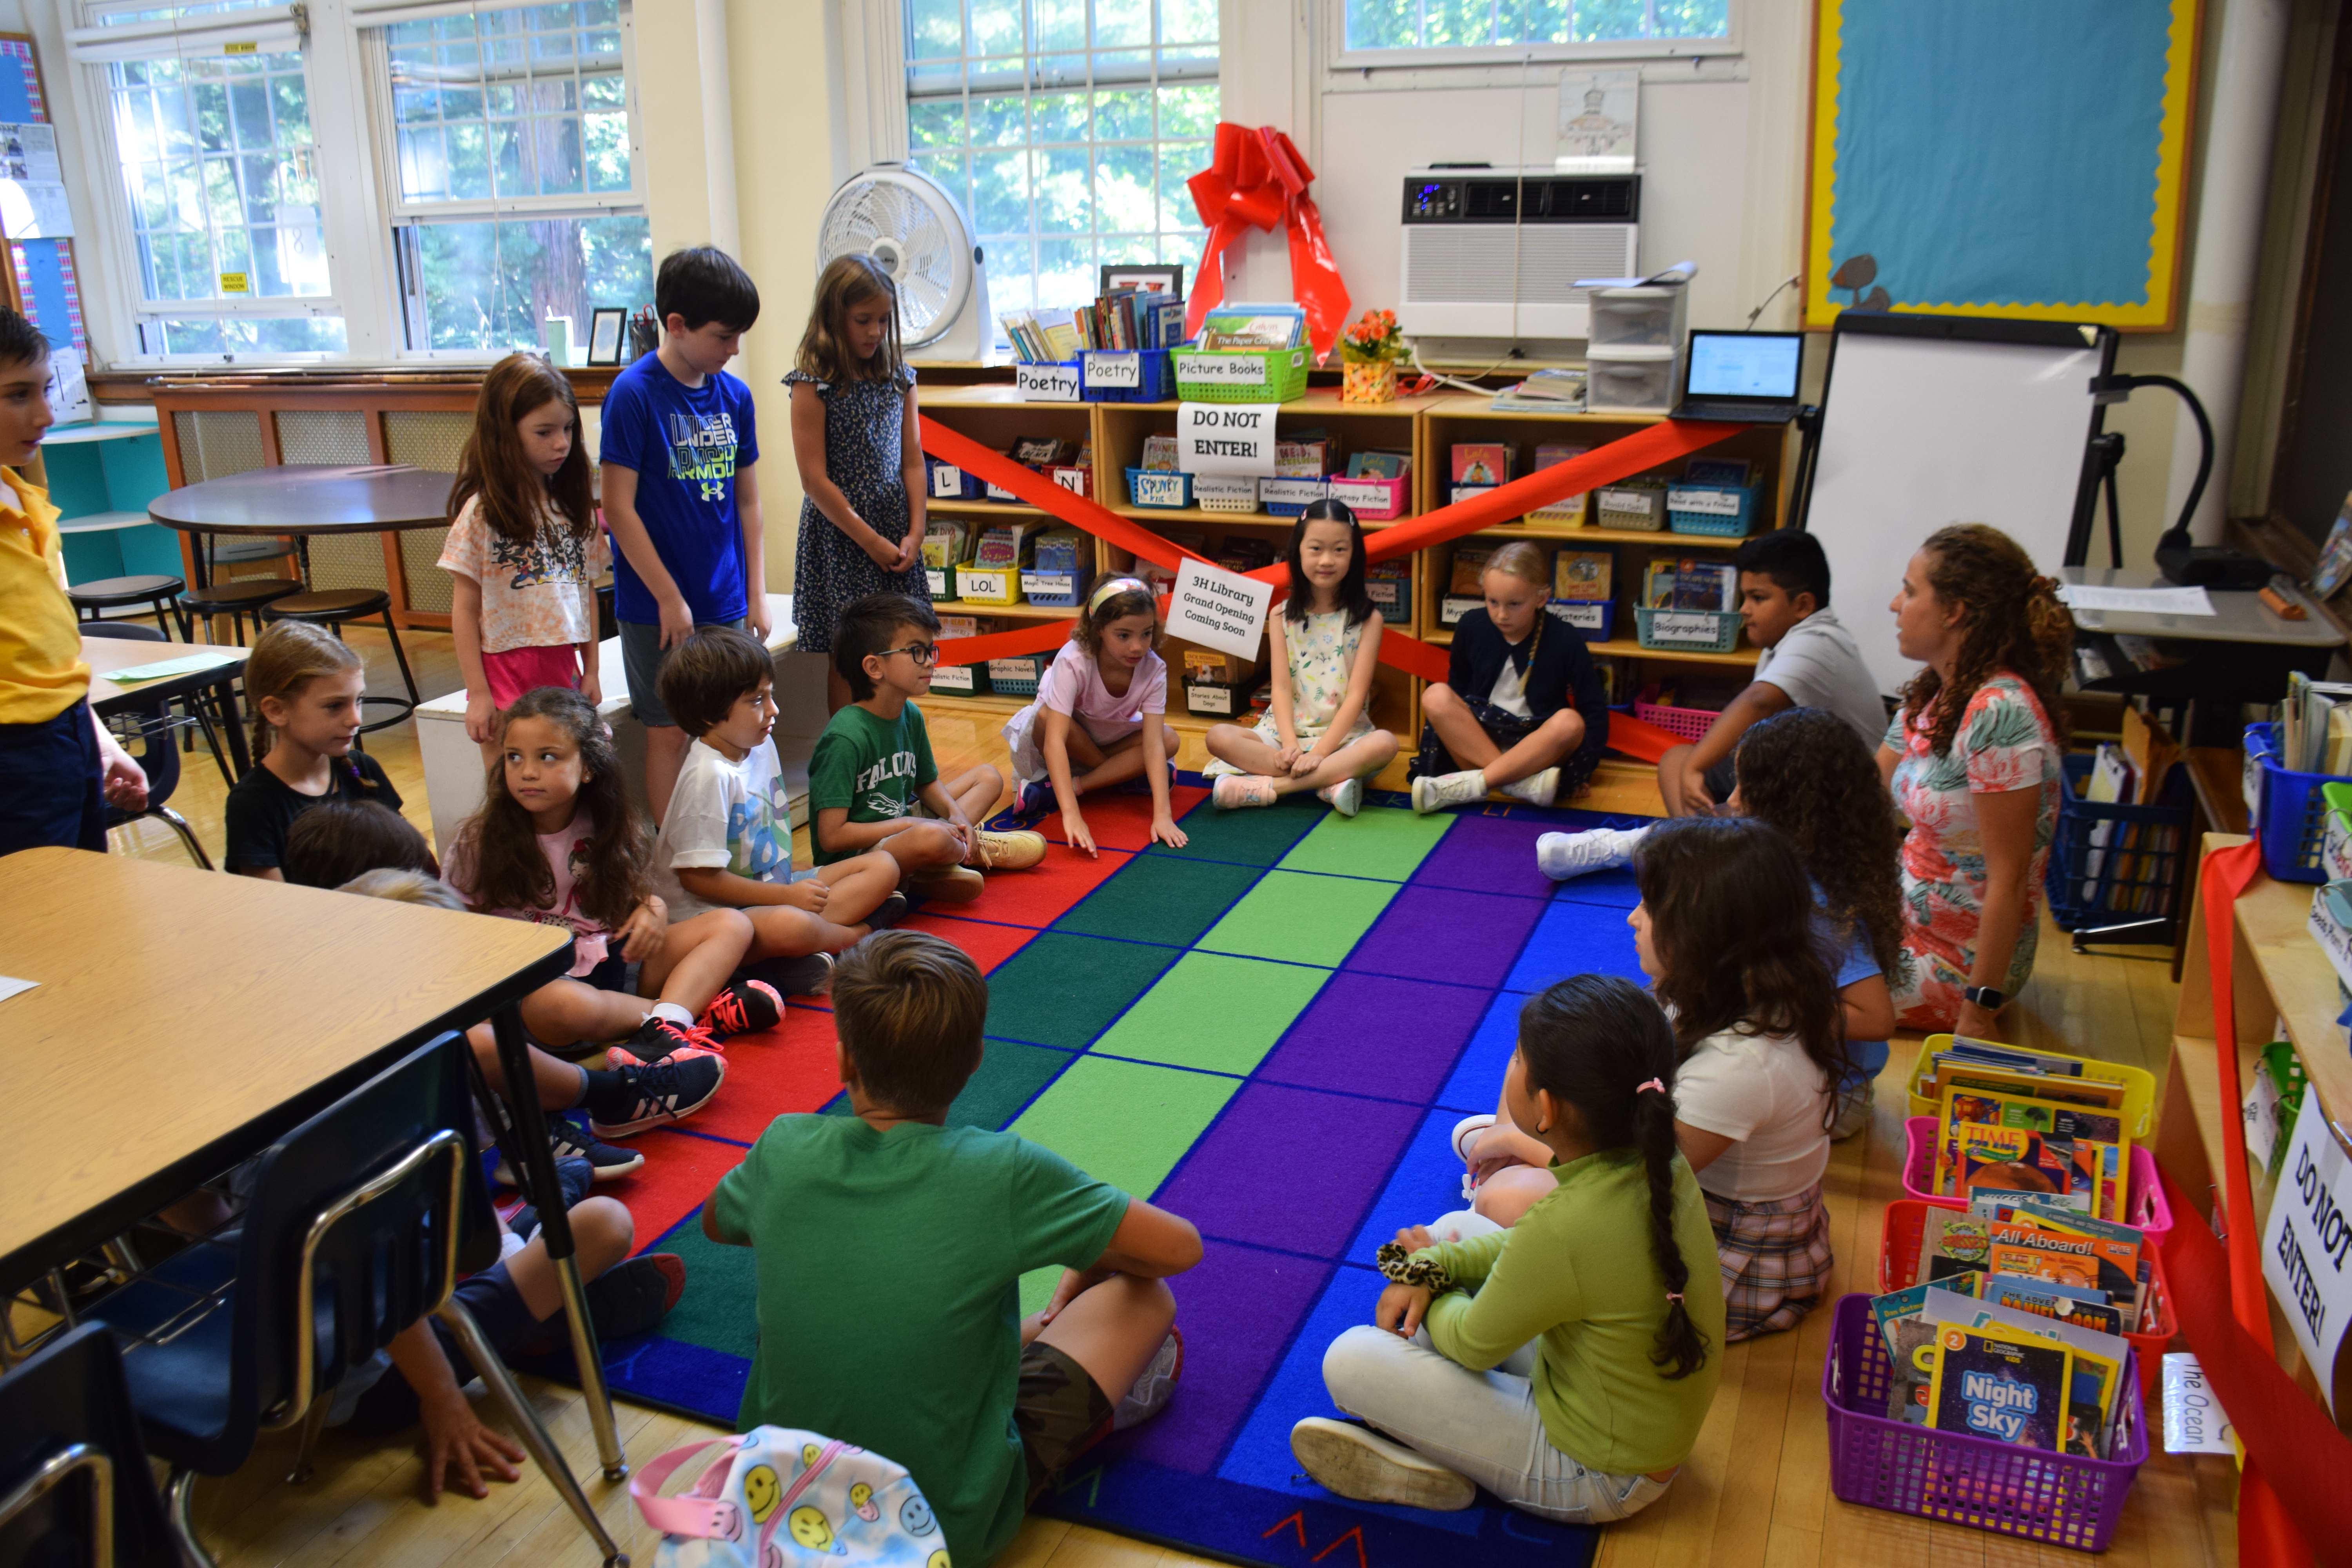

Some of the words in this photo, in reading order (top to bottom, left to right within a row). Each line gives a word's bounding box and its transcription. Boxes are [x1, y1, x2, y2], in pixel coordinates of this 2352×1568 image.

[1217, 336, 1230, 345] The
[1232, 336, 1253, 346] Paper
[1087, 362, 1136, 382] Poetry
[1179, 362, 1223, 375] Picture
[1230, 363, 1263, 375] Books
[1019, 372, 1077, 397] Poetry
[1193, 411, 1218, 426] DO
[1223, 412, 1261, 428] NOT
[1194, 439, 1258, 457] ENTER!
[942, 472, 951, 488] L
[1061, 475, 1075, 492] N
[1140, 478, 1178, 495] SPUNKY
[1194, 485, 1224, 494] Realistic
[1227, 486, 1252, 494] Fiction
[1265, 488, 1296, 497] Realistic
[1299, 489, 1324, 498] Fiction
[1330, 493, 1359, 503] Fantasy
[1362, 494, 1388, 503] Fiction
[971, 580, 996, 593] LOL
[1192, 576, 1209, 590] 3H
[1210, 582, 1254, 607] Library
[1184, 593, 1214, 610] Grand
[1215, 603, 1254, 625] Opening
[1185, 610, 1221, 631] Coming
[1222, 622, 1245, 637] Soon
[1654, 622, 1716, 635] Biographies
[1965, 1125, 2022, 1145] TIME
[2296, 1142, 2317, 1207] DO
[2310, 1182, 2352, 1273] NOT
[1942, 1234, 1990, 1249] GROSSEST
[1996, 1229, 2022, 1244] All
[2023, 1232, 2095, 1255] Aboard!
[2277, 1214, 2326, 1348] ENTER!
[2003, 1291, 2021, 1299] THE
[1899, 1303, 1924, 1313] Gutma
[1950, 1335, 1958, 1346] 2
[1994, 1343, 2019, 1352] NATIONAL
[1994, 1347, 2025, 1358] GEOGRAPHIC
[1965, 1375, 2033, 1410] Night
[1972, 1405, 2022, 1437] Sky
[2184, 1394, 2209, 1445] Ocean
